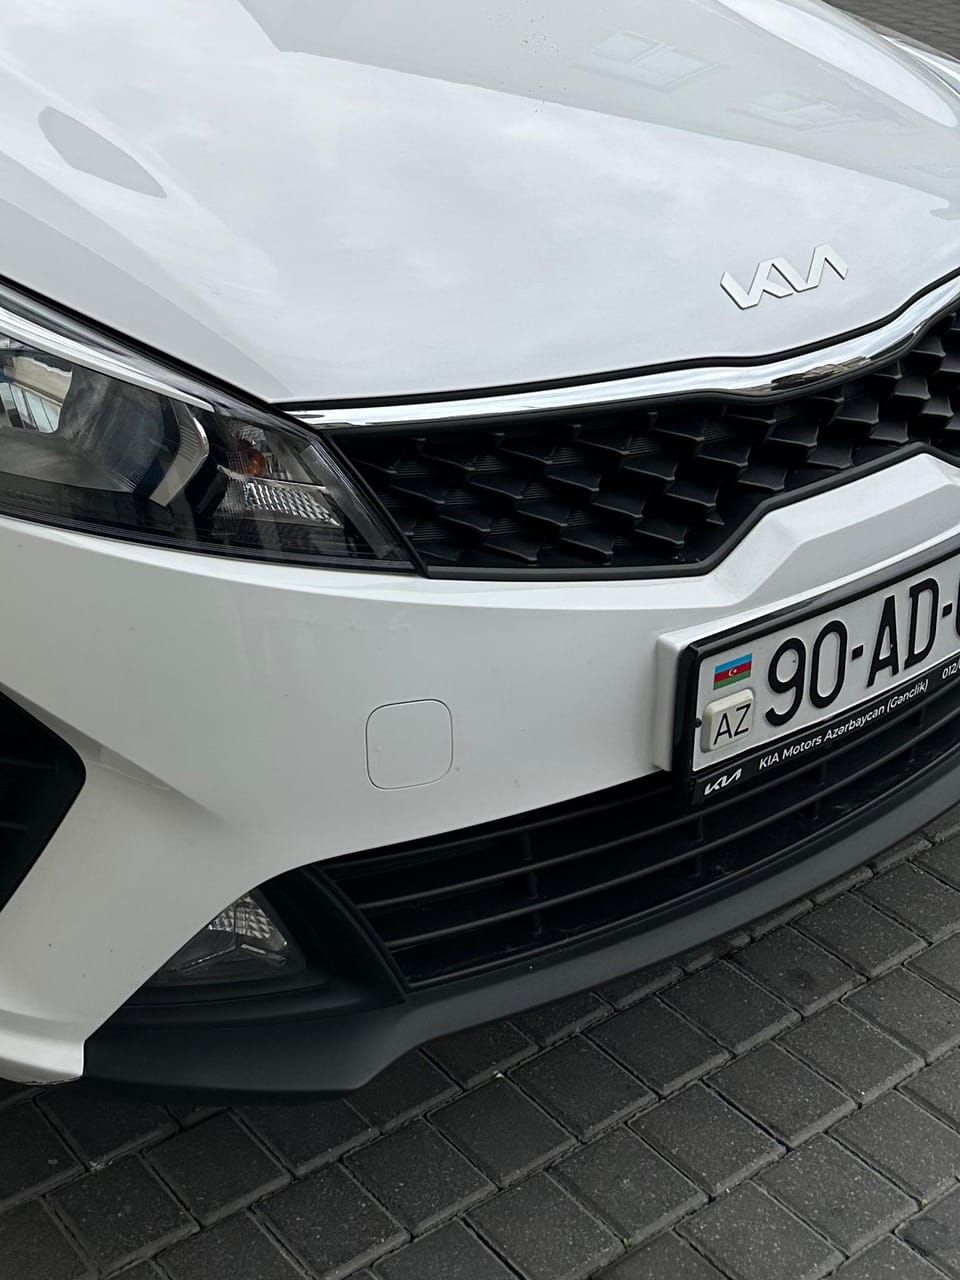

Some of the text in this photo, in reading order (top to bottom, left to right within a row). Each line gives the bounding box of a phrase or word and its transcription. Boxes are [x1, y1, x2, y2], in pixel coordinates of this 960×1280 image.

[765, 572, 960, 727] 90-AD-
[713, 703, 751, 746] AZ
[759, 752, 779, 770] KIA
[782, 735, 822, 759] Motors
